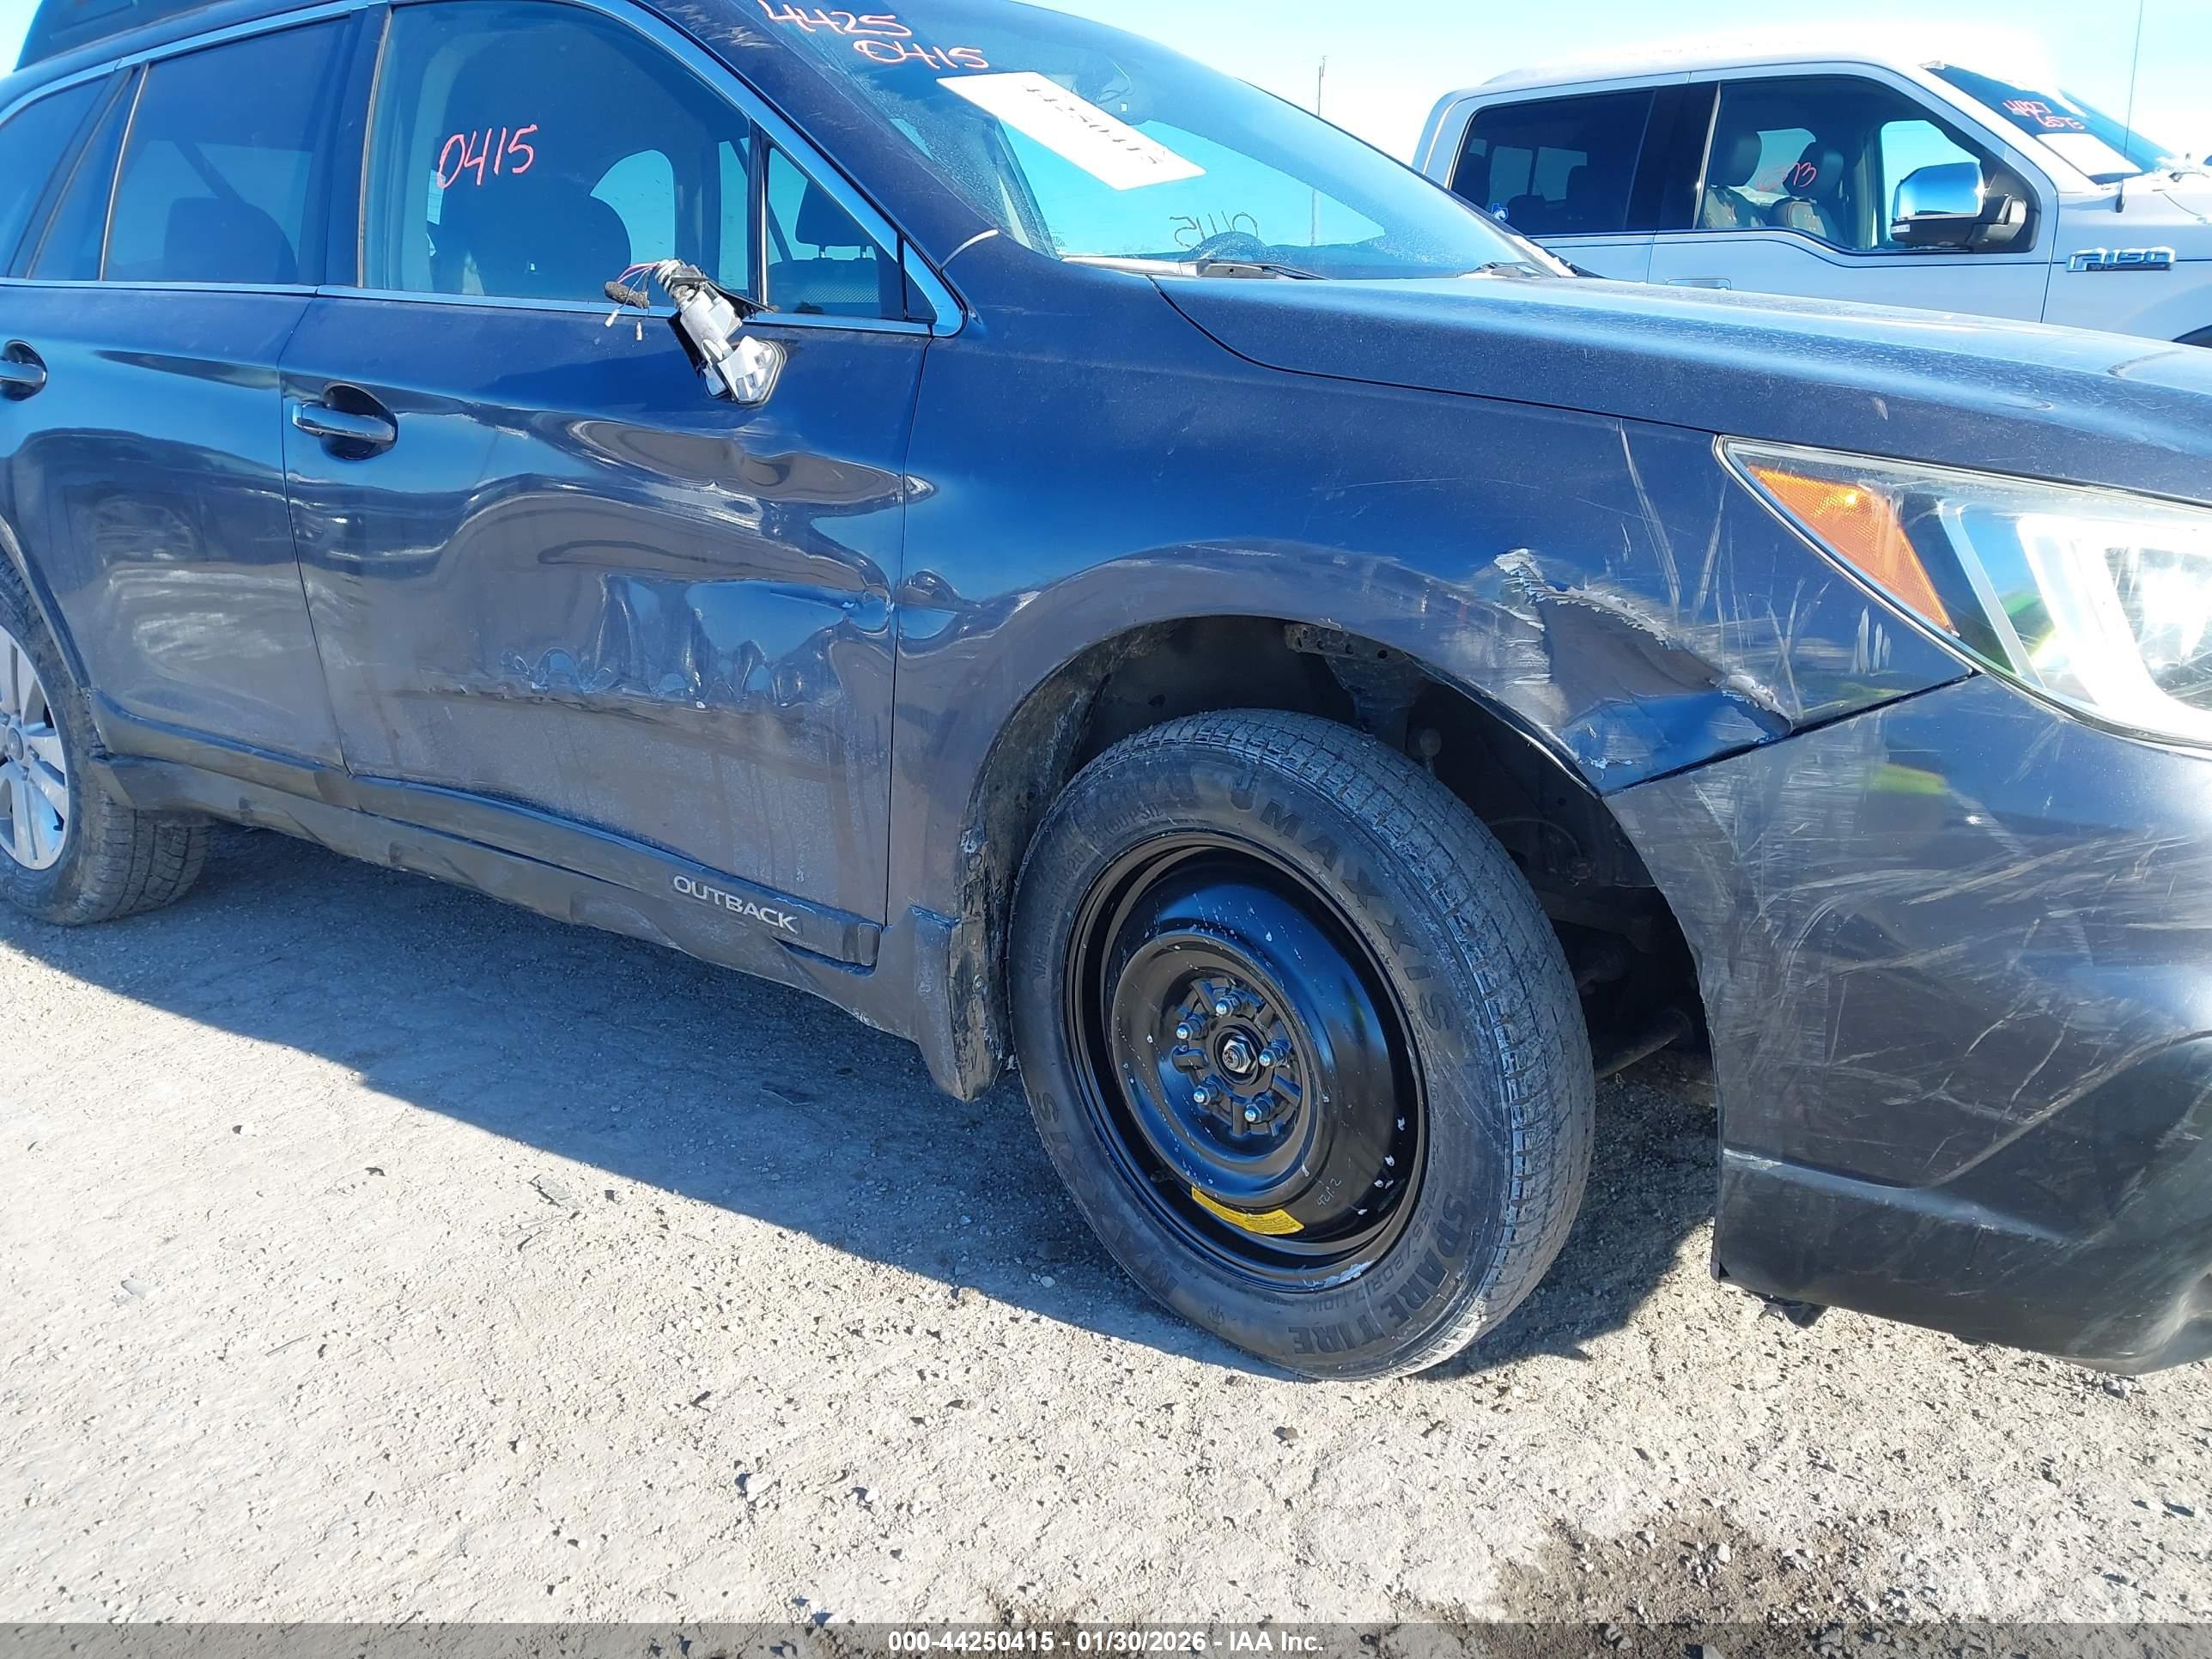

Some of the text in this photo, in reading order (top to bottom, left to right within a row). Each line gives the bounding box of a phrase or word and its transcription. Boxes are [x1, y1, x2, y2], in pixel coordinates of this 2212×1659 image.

[757, 0, 912, 36] 4425
[853, 40, 989, 69] 0415
[436, 124, 538, 189] 0415
[673, 874, 798, 935] OUTBACK
[1260, 797, 1455, 1031] MAXXIS
[1380, 1191, 1466, 1328] SPARE
[1287, 1313, 1386, 1355] TIRE
